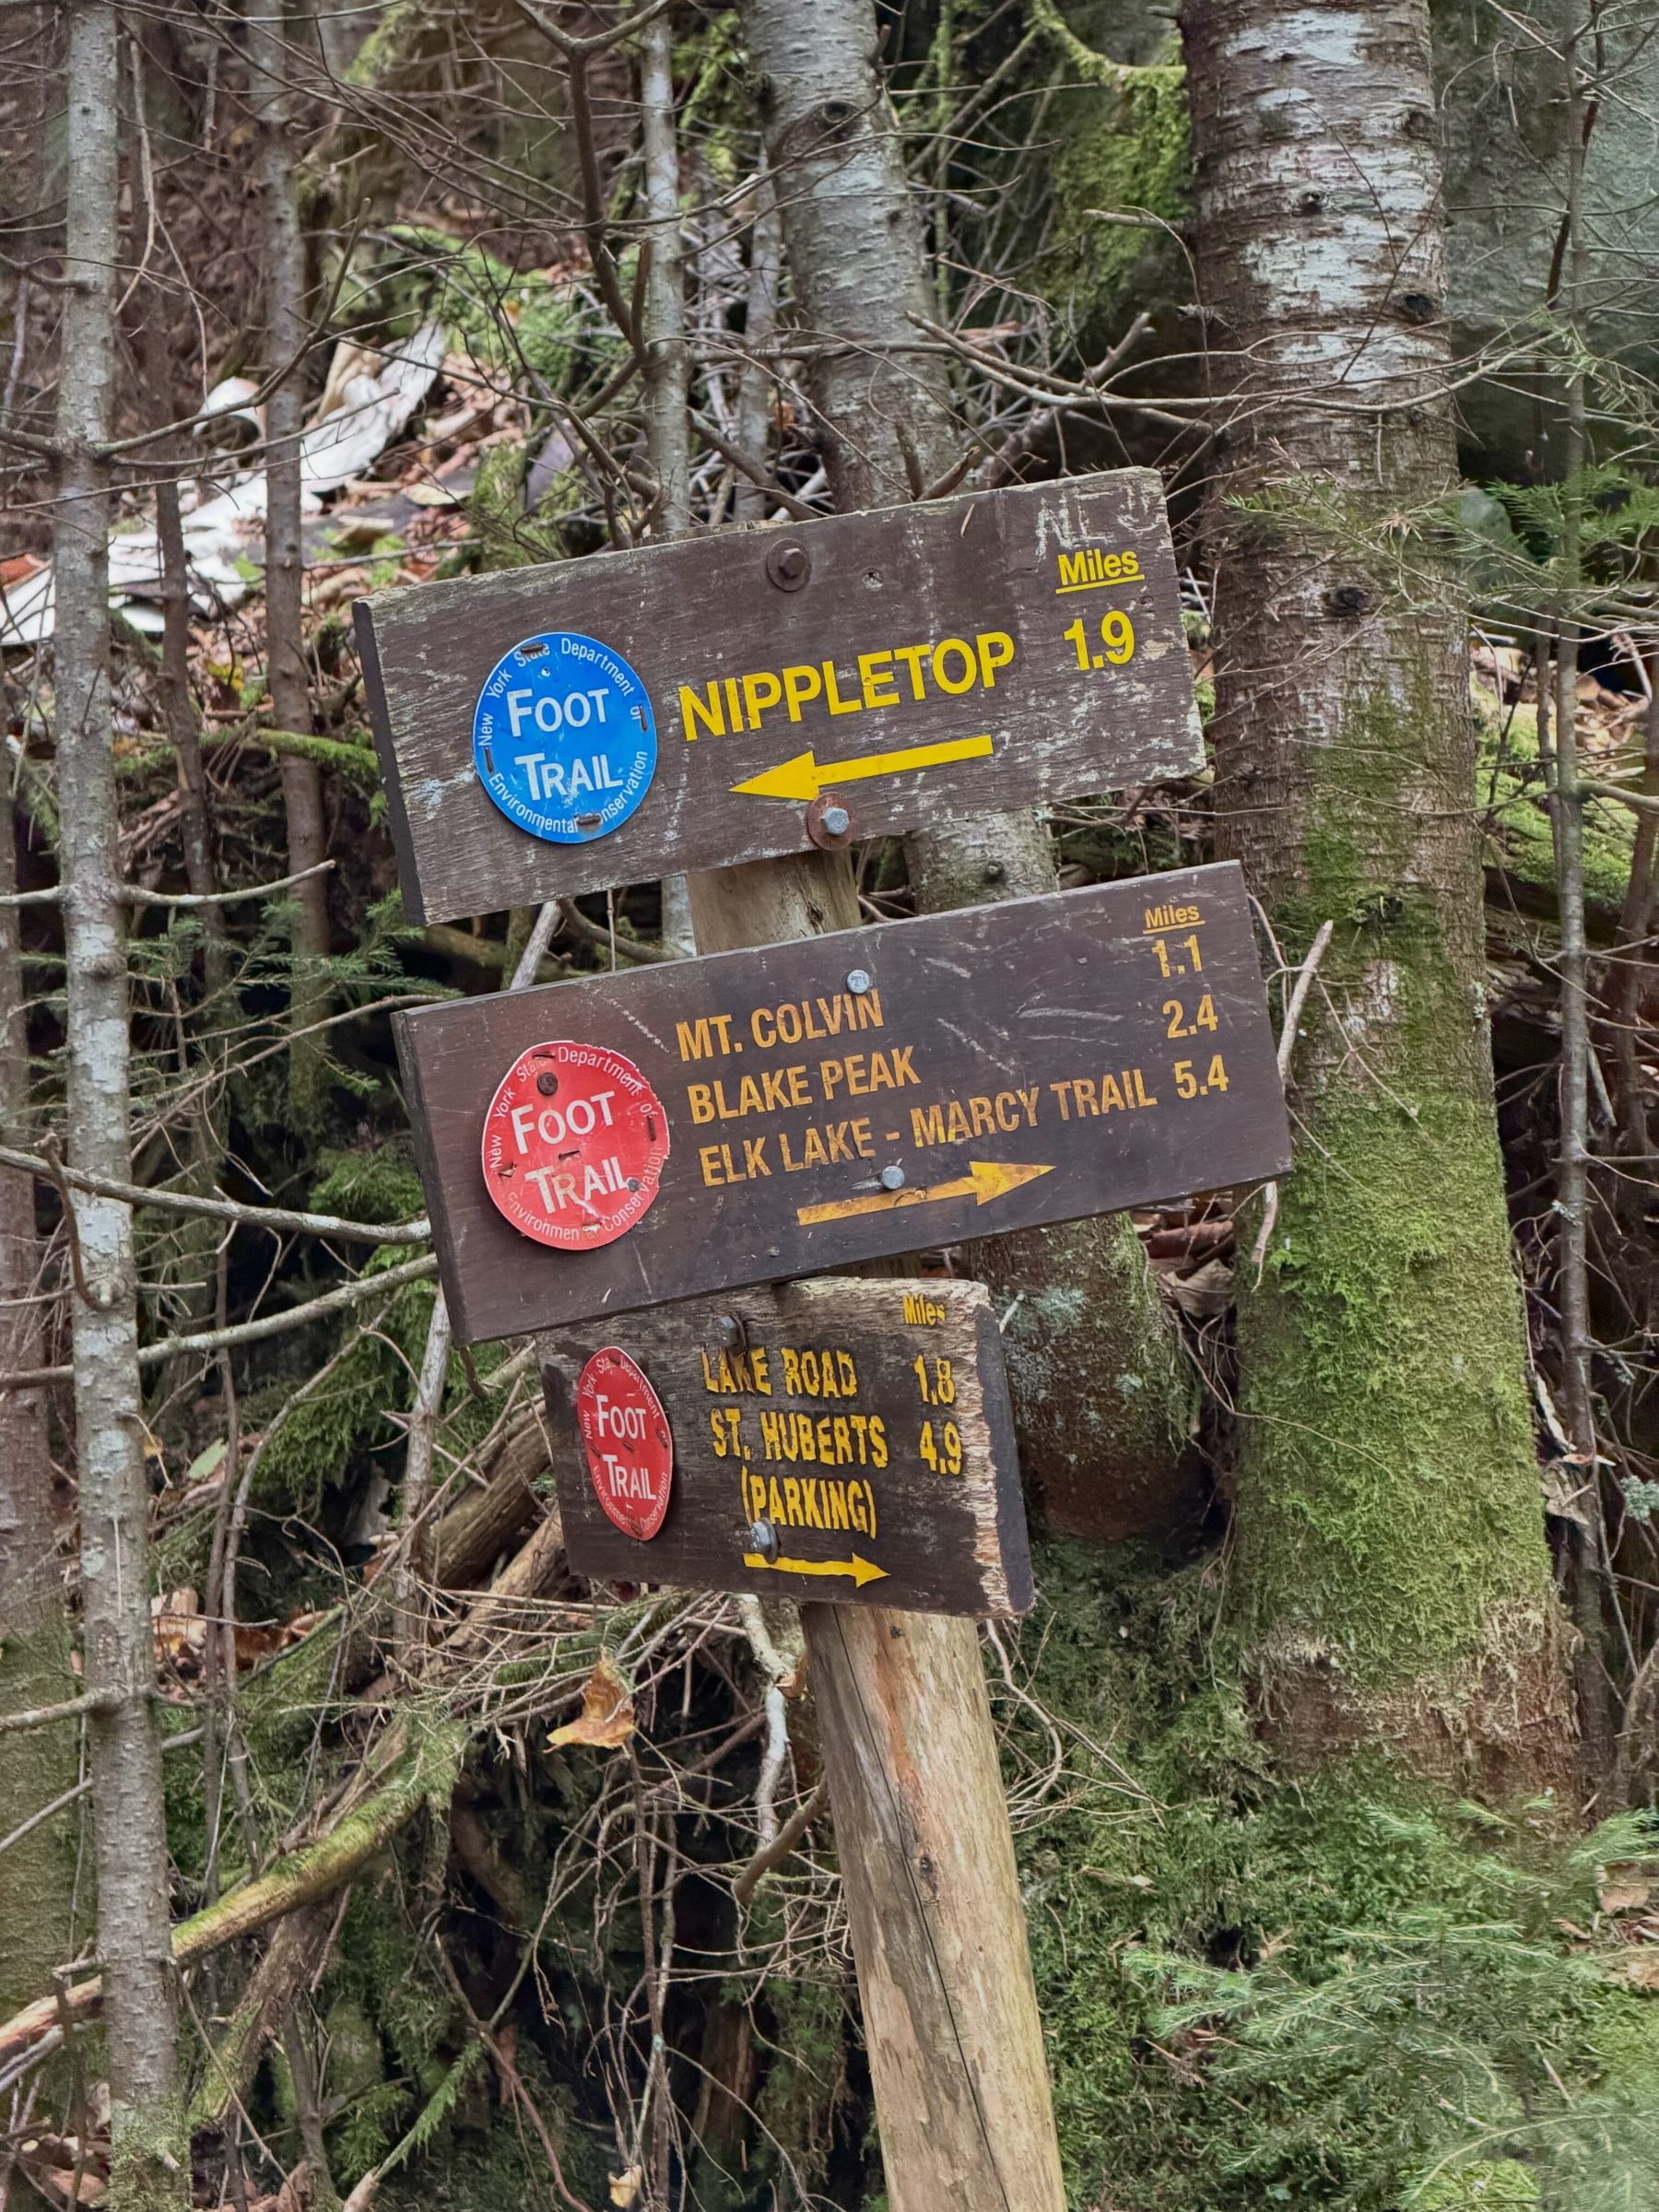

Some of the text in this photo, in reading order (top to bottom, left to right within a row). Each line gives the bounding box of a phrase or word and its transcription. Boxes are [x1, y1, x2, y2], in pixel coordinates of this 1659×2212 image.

[1058, 548, 1139, 586] Miles
[477, 712, 494, 746] New
[486, 667, 513, 700] York
[561, 637, 635, 698] Department
[678, 610, 1135, 741] NIPPLETOP 1.9
[488, 750, 648, 833] Environmental onservation
[1145, 903, 1200, 929] Miles
[676, 934, 1204, 1062] MT. COLVIN 1.1
[558, 1046, 643, 1097] Department
[688, 994, 1219, 1125] BLAKE PEAK 2.4
[493, 1087, 516, 1119] York
[699, 1138, 772, 1188] ELK
[779, 1117, 876, 1172] LAKE
[910, 1087, 1040, 1148] MARCY
[1050, 1068, 1158, 1123] TRAIL
[1174, 1054, 1230, 1100] 5.4
[489, 1135, 502, 1169] New
[509, 1192, 598, 1242] Environmena
[902, 1292, 946, 1325] Miles
[582, 1373, 598, 1399] York
[596, 1357, 616, 1374] Sta
[700, 1347, 956, 1406] LAKE ROAD 1.8
[710, 1407, 962, 1475] ST. HUBERTS 4.9
[593, 1464, 634, 1528] Environmen
[741, 1465, 877, 1540] (PARKING)
